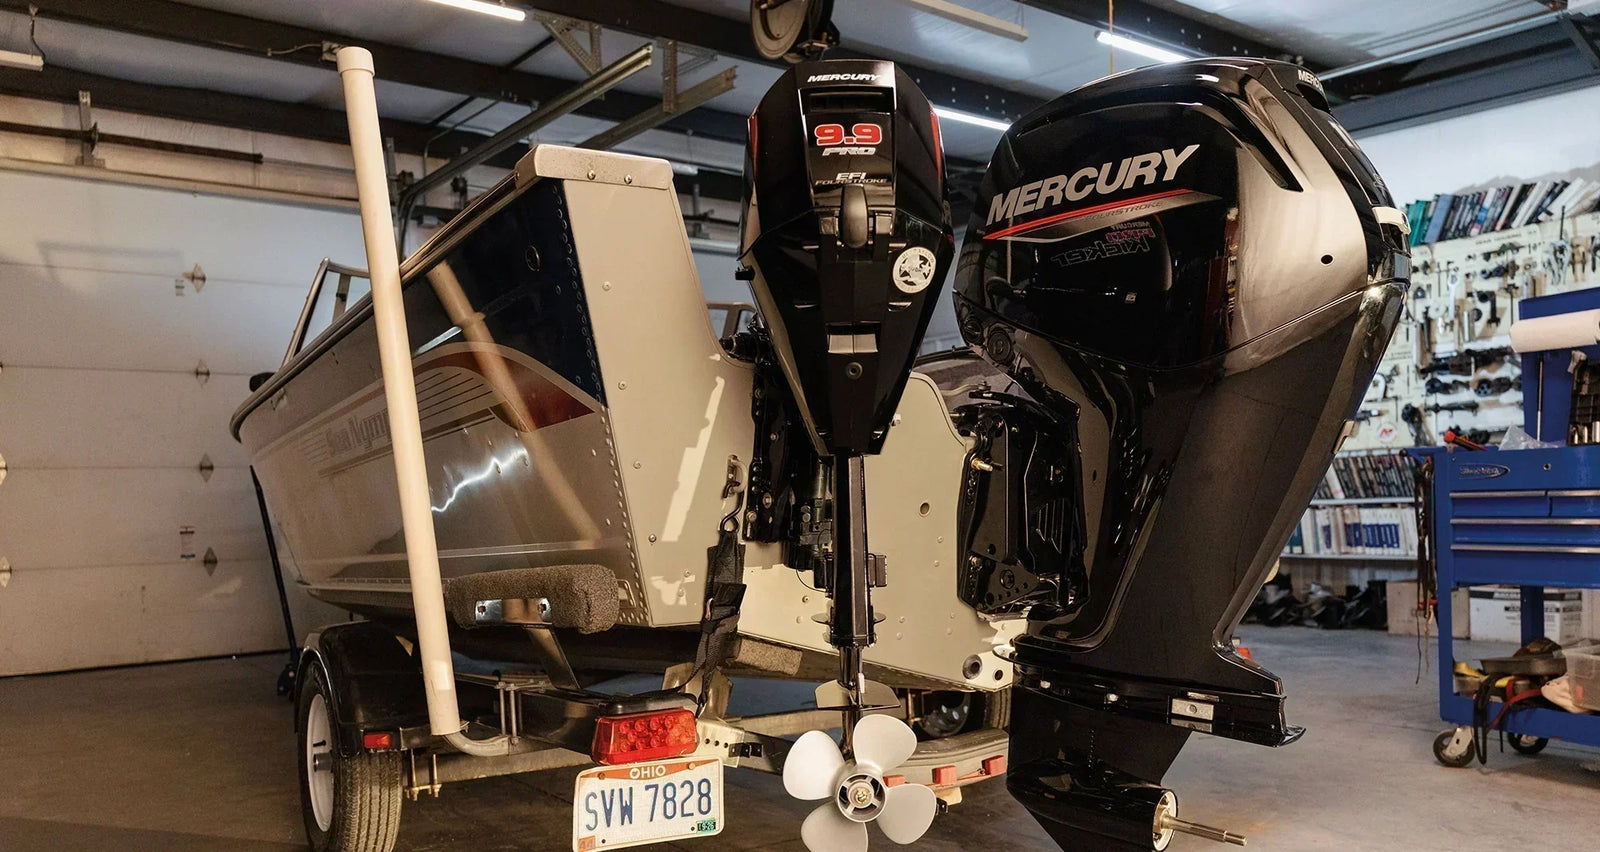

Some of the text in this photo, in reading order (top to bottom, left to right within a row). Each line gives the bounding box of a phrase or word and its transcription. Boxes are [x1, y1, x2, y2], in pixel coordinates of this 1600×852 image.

[807, 73, 881, 83] MERCURY
[814, 123, 882, 146] 9.9
[822, 146, 876, 157] PRO
[815, 177, 888, 186] FOURSTROKE
[836, 171, 867, 181] EFI
[985, 144, 1200, 226] MERCURY
[629, 765, 666, 780] OHIO
[585, 777, 712, 832] SVW 7828
